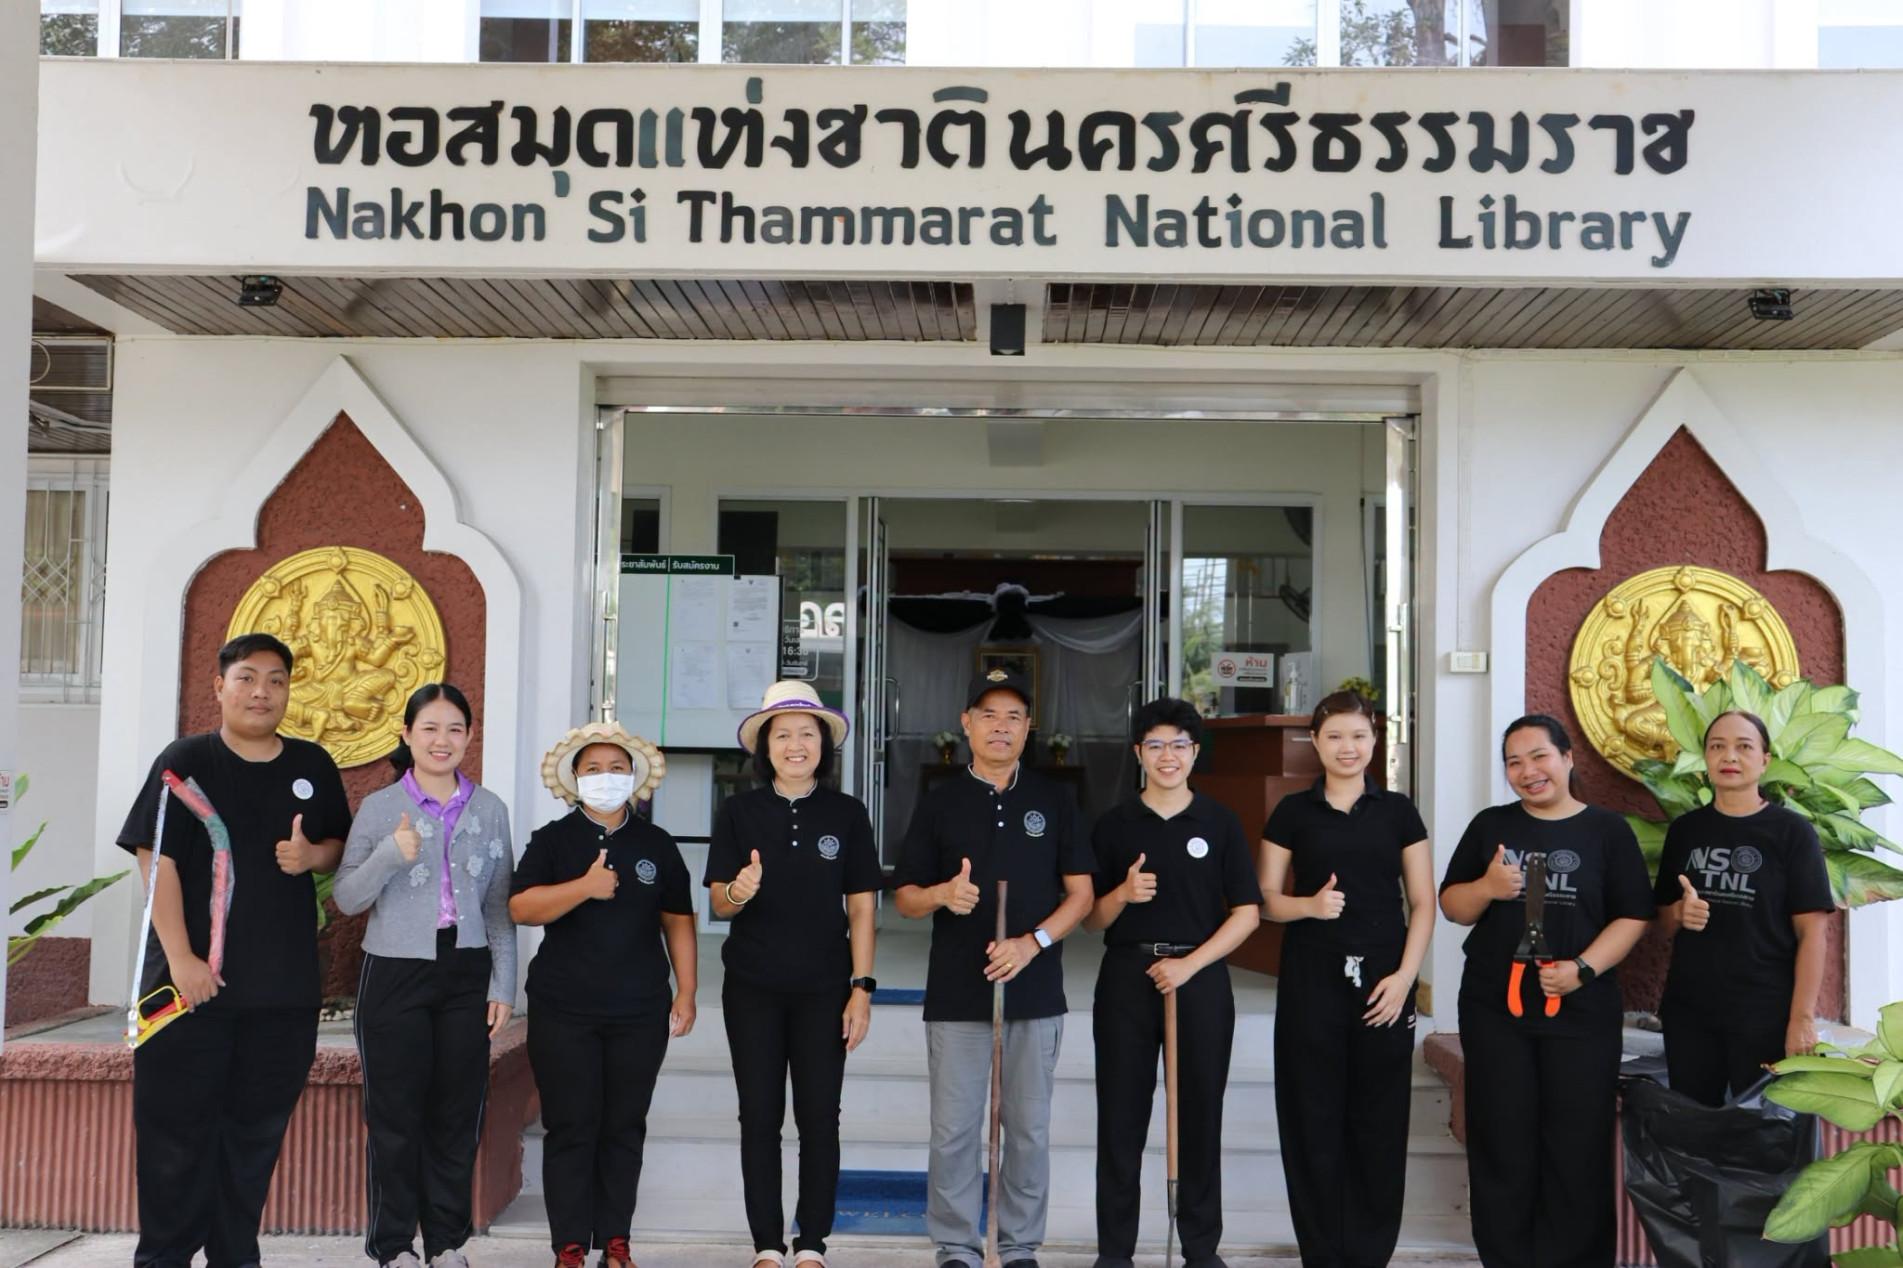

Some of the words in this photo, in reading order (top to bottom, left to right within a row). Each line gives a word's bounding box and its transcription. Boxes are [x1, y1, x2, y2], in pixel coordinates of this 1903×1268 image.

[305, 187, 545, 242] Nakhon
[588, 188, 646, 243] Si
[677, 190, 1056, 246] Thammarat
[1105, 192, 1387, 249] National
[1438, 194, 1691, 267] Library
[621, 559, 667, 569] ระชาสัมพันธ์
[1700, 870, 1756, 894] TNL
